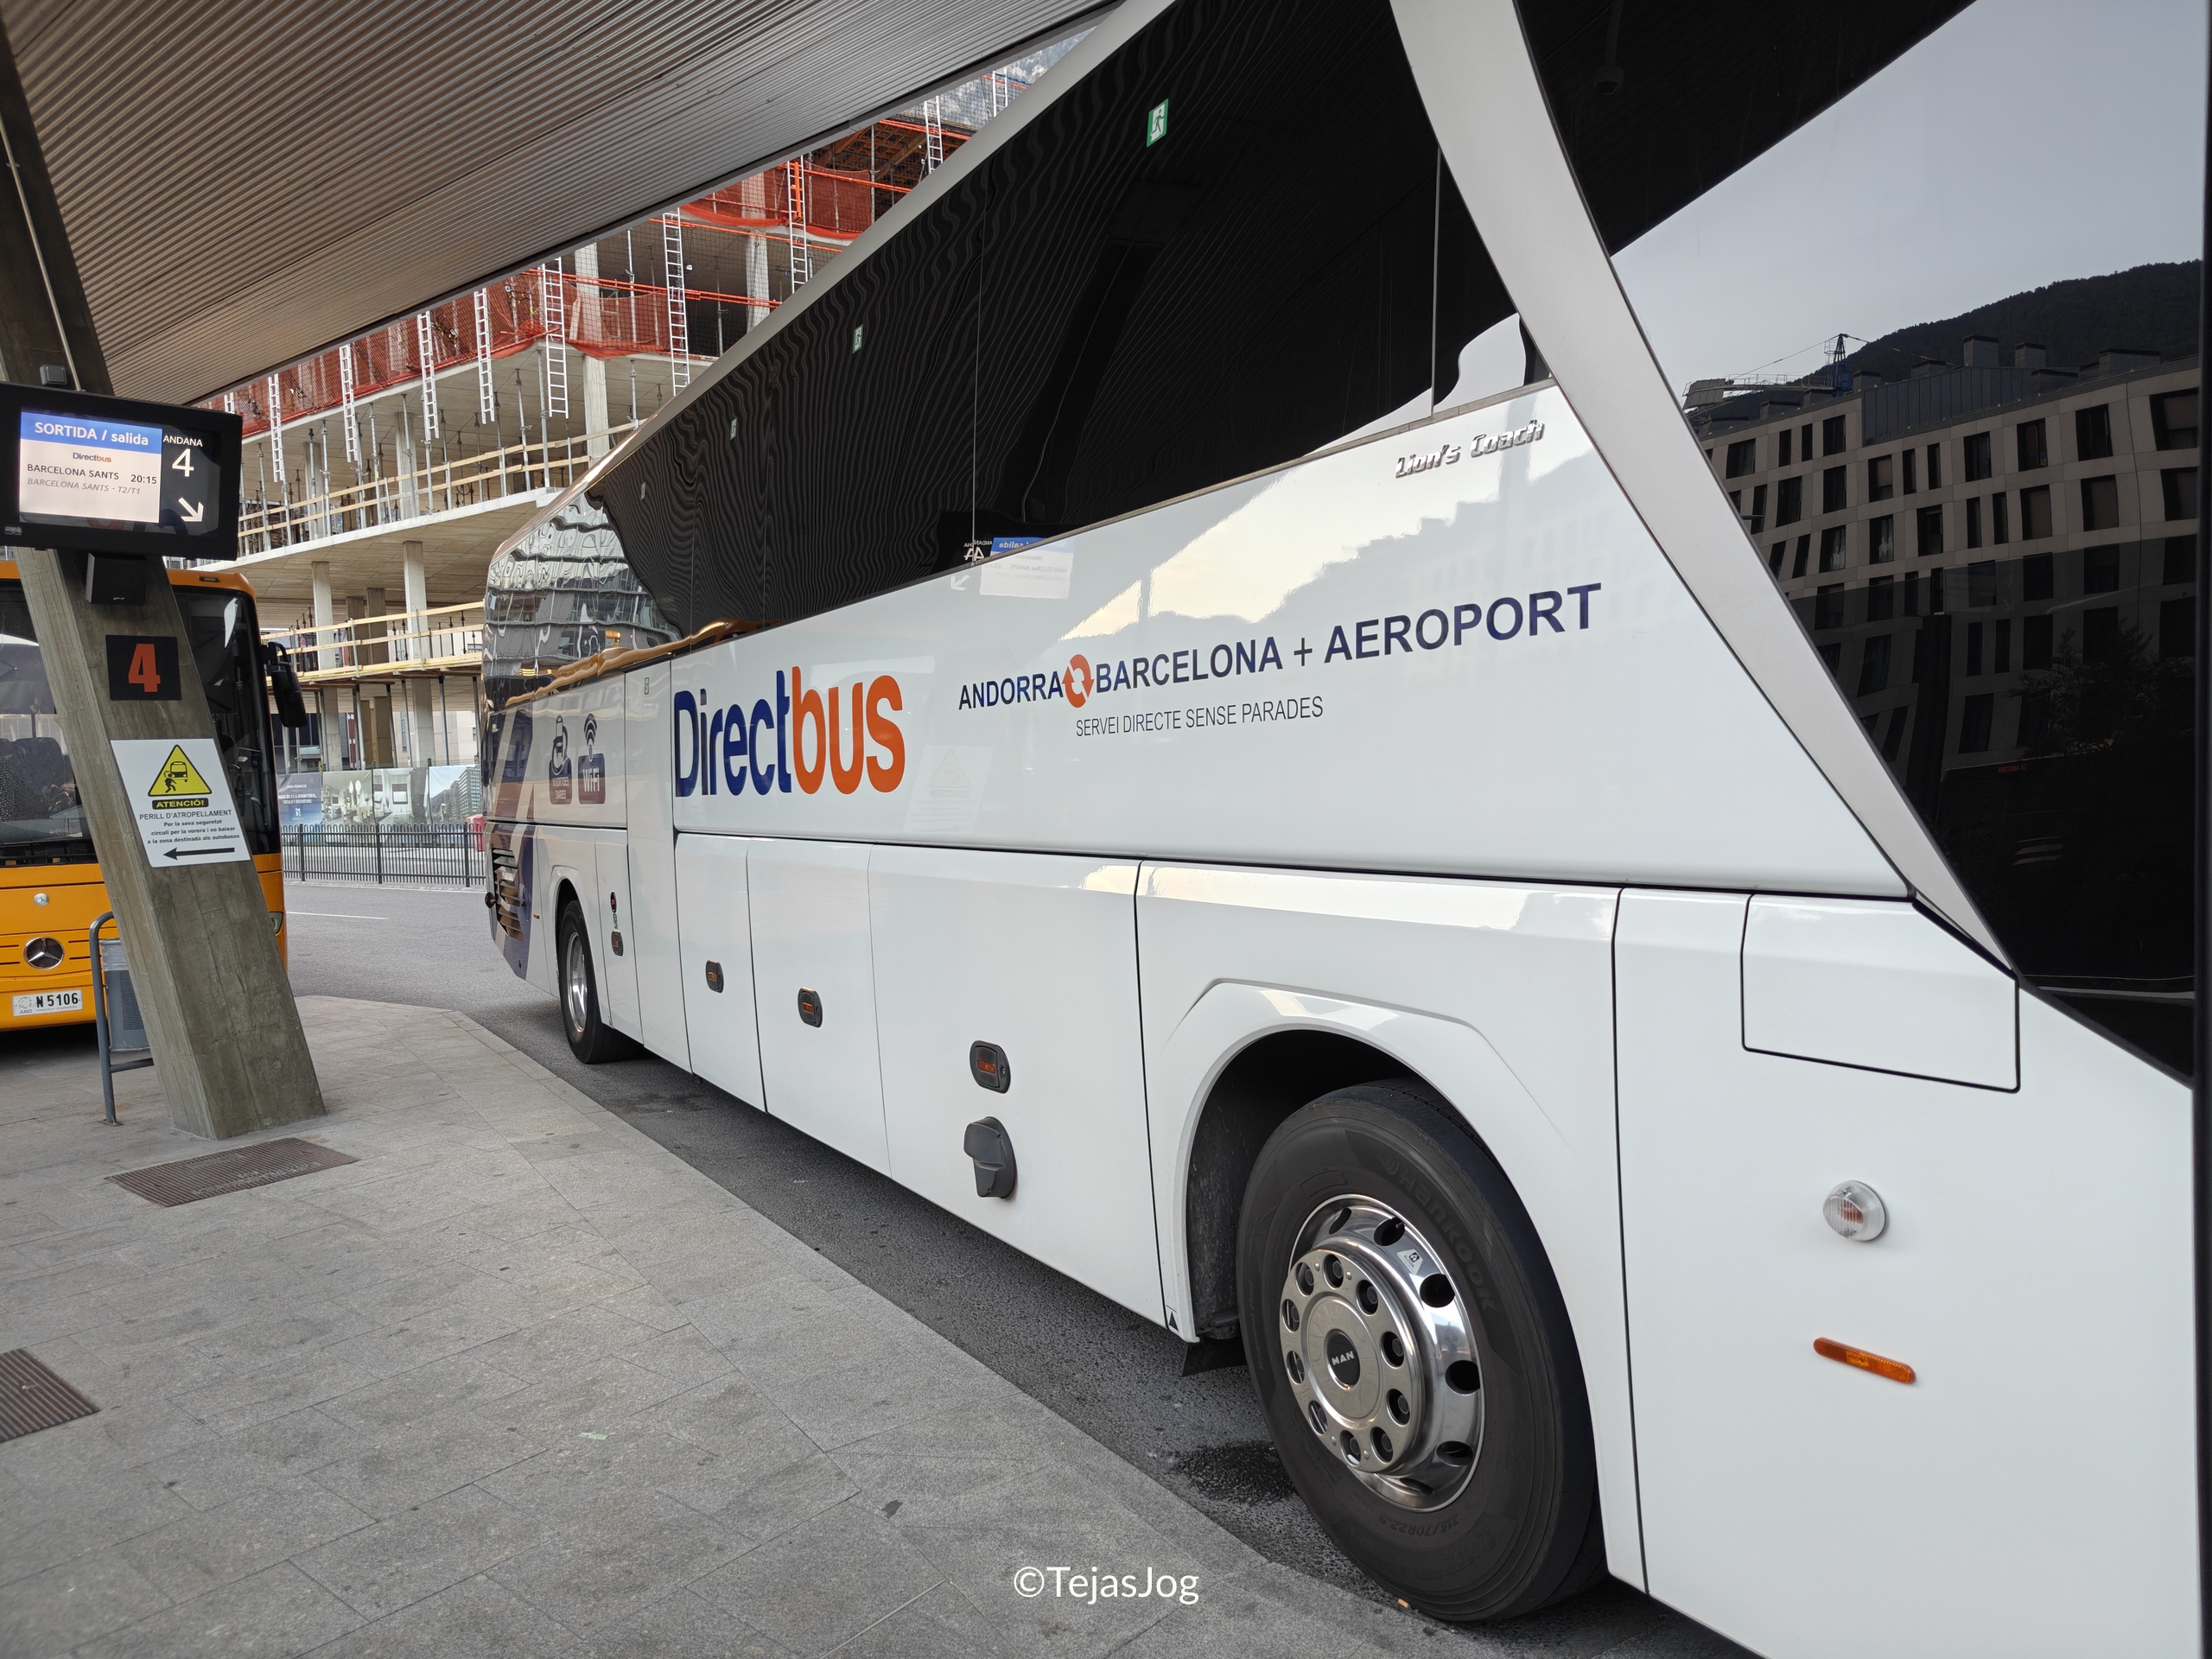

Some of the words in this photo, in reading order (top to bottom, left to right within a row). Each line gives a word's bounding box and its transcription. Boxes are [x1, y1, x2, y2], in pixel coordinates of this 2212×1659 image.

[35, 422, 98, 441] SORTIDA
[101, 429, 108, 442] /
[111, 432, 149, 446] salida
[163, 435, 203, 448] ANDANA
[73, 452, 112, 463] Directbus
[1395, 444, 1462, 478] Lion's
[1470, 419, 1545, 458] Coach
[27, 463, 86, 477] BARCELONA
[89, 469, 119, 480] SANTS
[130, 474, 157, 485] 20:15
[171, 448, 194, 478] 4
[27, 478, 79, 489] BARCELONA
[82, 483, 109, 493] SANTS
[118, 486, 141, 495] T2/T1
[958, 671, 1064, 710] ANDORRA
[1096, 636, 1283, 694] BARCELONA
[1294, 637, 1313, 667] +
[1324, 582, 1602, 664] AEROPORT
[128, 643, 162, 693] 4
[1076, 716, 1119, 737] SERVEI
[1123, 709, 1181, 734] DIRECTE
[1185, 704, 1236, 728] SENSE
[1242, 696, 1324, 723] PARADES
[673, 665, 906, 798] Directbus
[156, 799, 205, 809] ATENCIÓ!
[166, 809, 232, 819] D'ATROPELLAMENT
[36, 995, 44, 1008] N
[47, 992, 79, 1007] 5106
[1332, 1351, 1355, 1365] MAN
